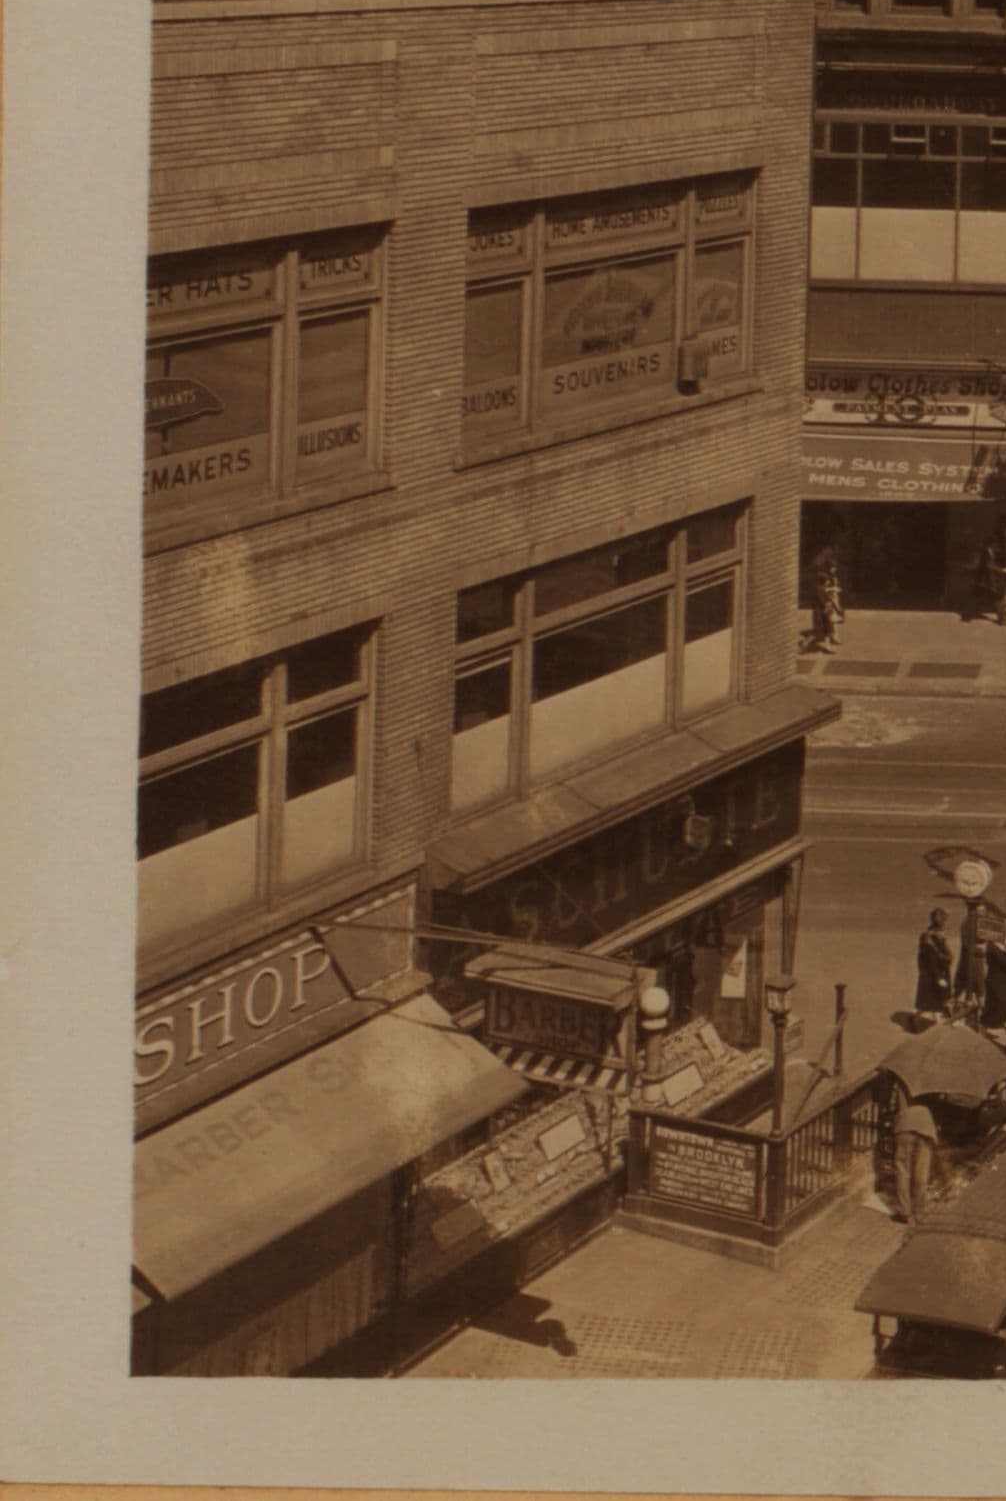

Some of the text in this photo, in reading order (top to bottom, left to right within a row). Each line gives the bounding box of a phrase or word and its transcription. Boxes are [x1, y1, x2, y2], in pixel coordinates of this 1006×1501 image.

[551, 206, 670, 239] HOME AMUSEMENTS
[471, 231, 516, 252] JOKES
[310, 254, 361, 280] TRICKS
[186, 272, 254, 300] HATS
[552, 352, 661, 395] SOUVENIRS
[299, 421, 362, 457] ILLUSIONS
[144, 449, 252, 495] MAKERS
[851, 457, 910, 474] SALES
[808, 473, 866, 489] MENS
[876, 477, 984, 496] CLOTHING
[135, 943, 331, 1087] SHOP
